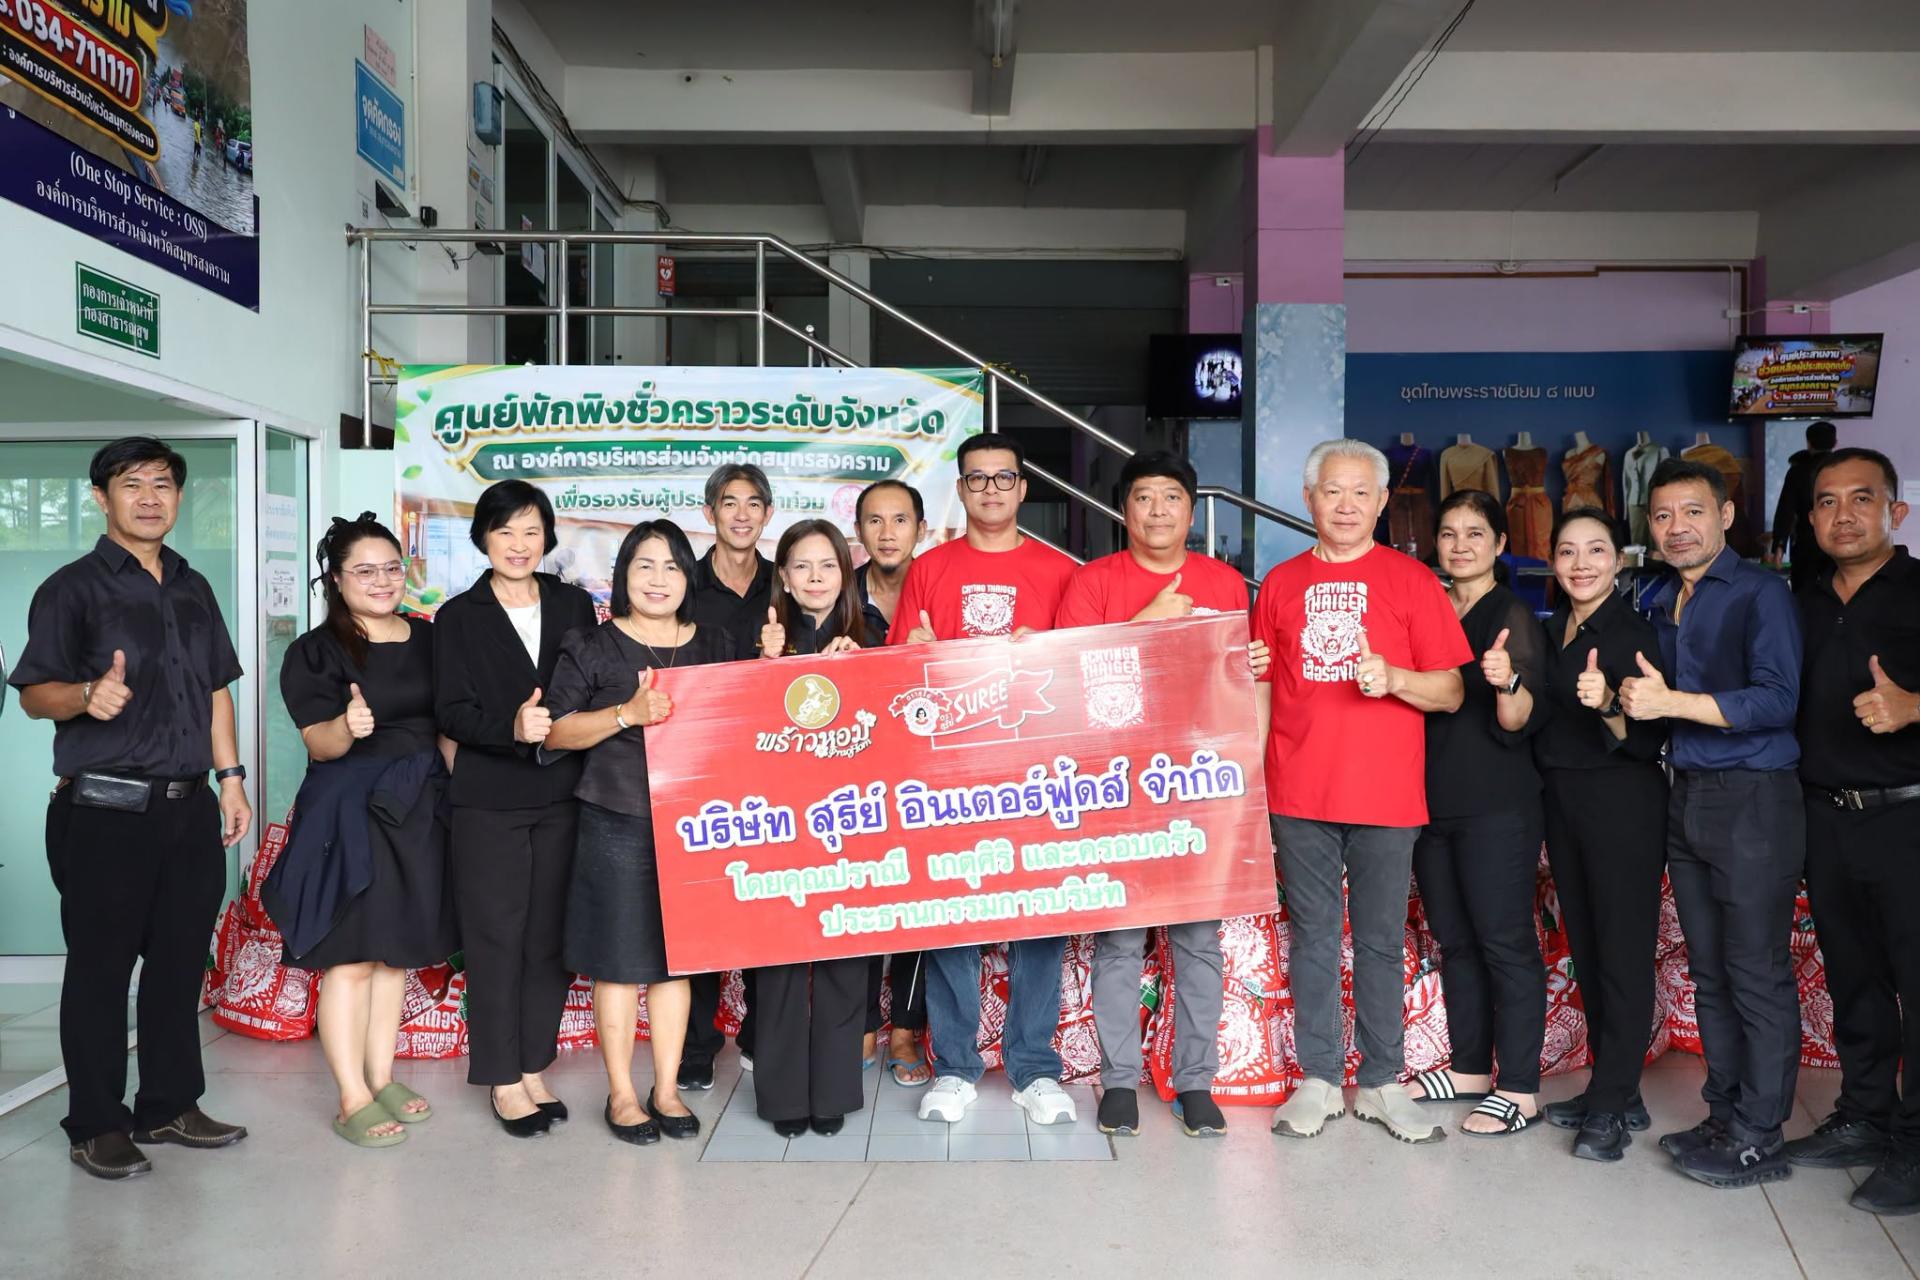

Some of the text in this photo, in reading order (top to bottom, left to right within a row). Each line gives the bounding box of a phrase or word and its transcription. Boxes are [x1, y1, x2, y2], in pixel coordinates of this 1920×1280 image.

[70, 151, 101, 184] (One
[104, 169, 132, 203] Stop
[134, 185, 174, 224] Service
[184, 213, 208, 244] OSS)
[36, 177, 231, 286] องค์การบริหารส่วนจังหวัดสมุทรสงคราม
[433, 380, 947, 445] ศูนย์พักพิงชั่วคราวระดับจังหวัด
[1400, 382, 1541, 404] ชุดไทยพระราชนิยม
[1564, 385, 1596, 399] แบบ
[492, 453, 515, 471] ณ
[953, 678, 1009, 723] SUREE
[679, 754, 1240, 849] บริษัท สุรีย์ อินเตอร์ฟู้ดส์ จำกัด
[727, 820, 1206, 905] โดยคุณปราณี เกตุศิริ และครอบครัว
[821, 873, 1126, 934] ประธานกรรมการบริษัท
